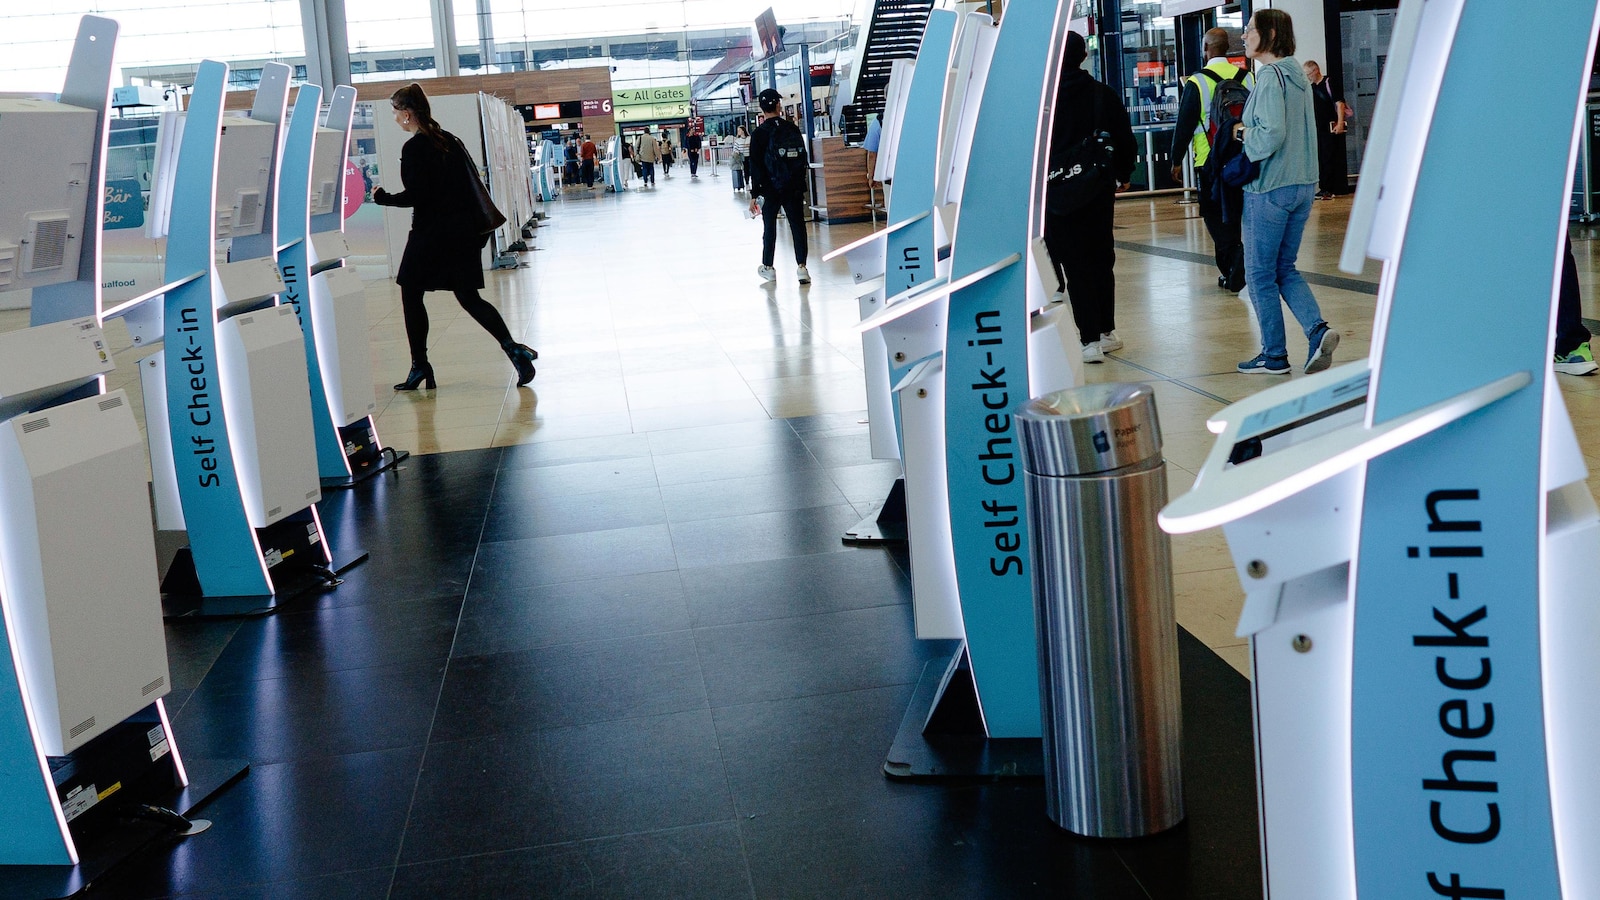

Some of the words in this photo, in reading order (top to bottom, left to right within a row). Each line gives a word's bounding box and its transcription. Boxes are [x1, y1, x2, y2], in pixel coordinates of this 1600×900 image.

[602, 99, 611, 112] 6
[634, 91, 649, 101] All
[654, 89, 684, 99] Gates
[678, 104, 685, 115] 5
[177, 307, 212, 427] Check-in
[967, 310, 1018, 486] Check-in
[190, 436, 220, 488] Self
[981, 499, 1024, 577] Self
[1407, 488, 1502, 845] Check-in
